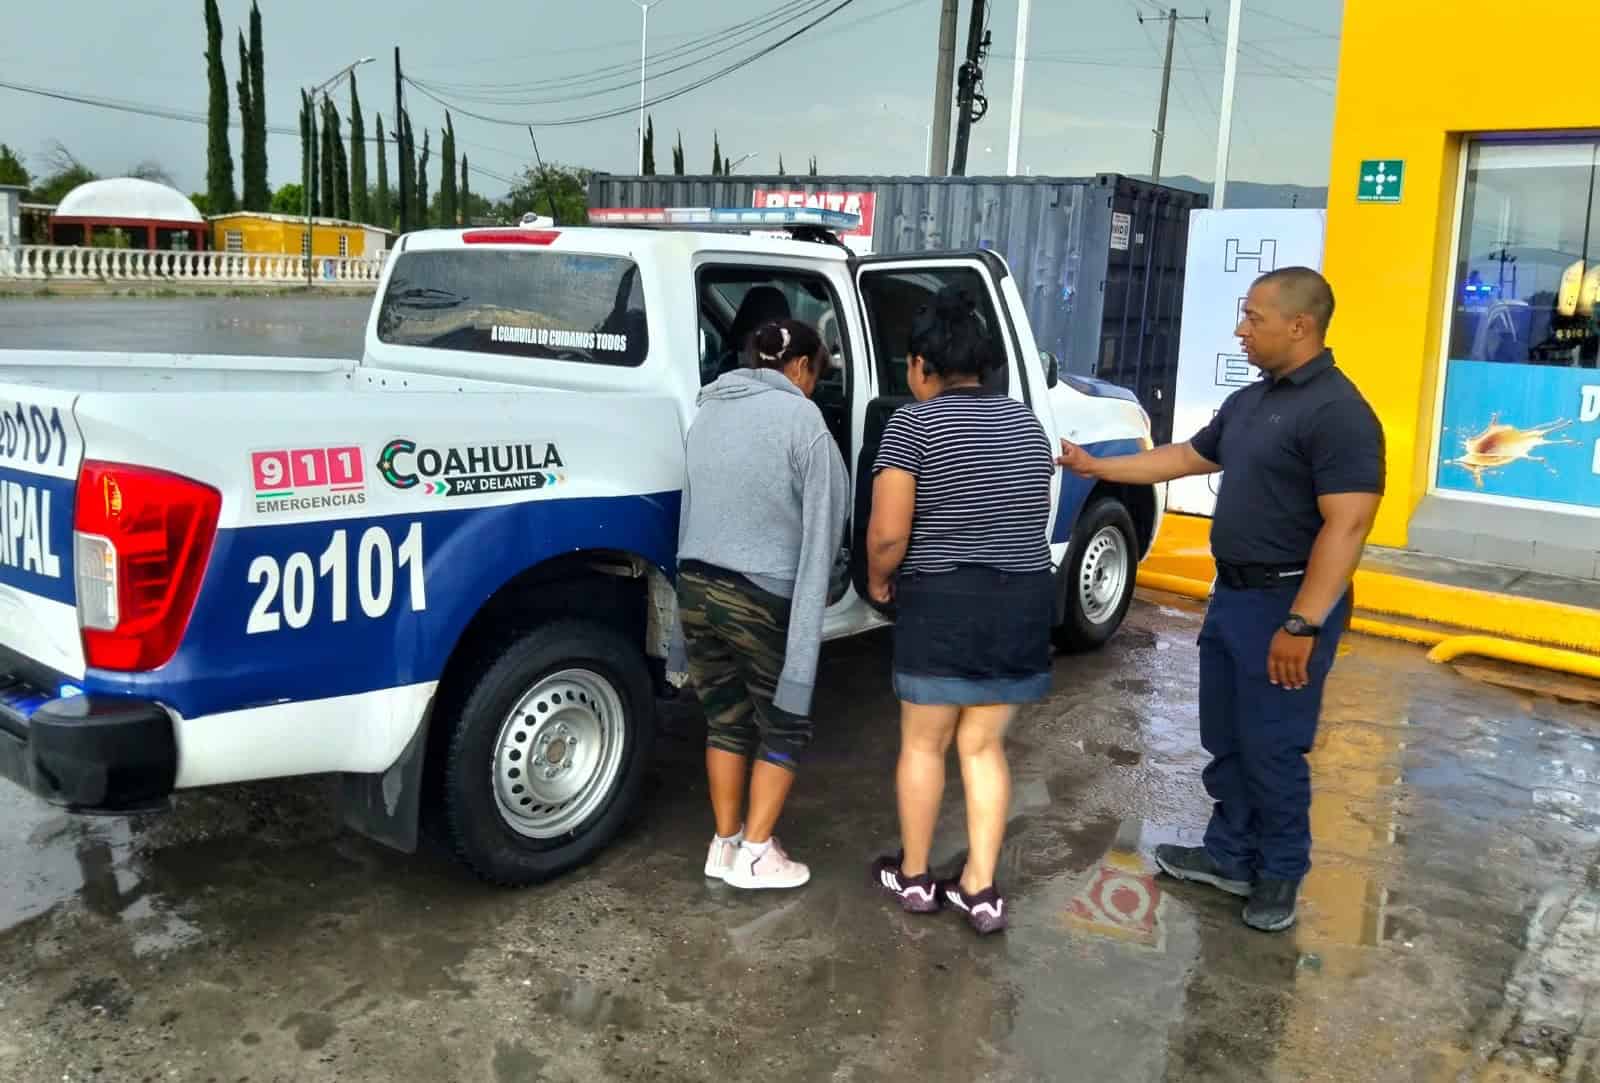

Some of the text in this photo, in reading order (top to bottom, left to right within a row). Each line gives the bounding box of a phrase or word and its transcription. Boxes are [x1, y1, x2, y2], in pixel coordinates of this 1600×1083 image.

[491, 325, 627, 351] A COAHUILA LO CUIDAMOS TODOS
[259, 450, 354, 485] 911
[376, 439, 564, 489] COAHUILA
[479, 475, 537, 490] DELANTE
[256, 493, 366, 513] EMERGENCIAS
[0, 479, 61, 578] IPAL
[246, 521, 426, 634] 20101
